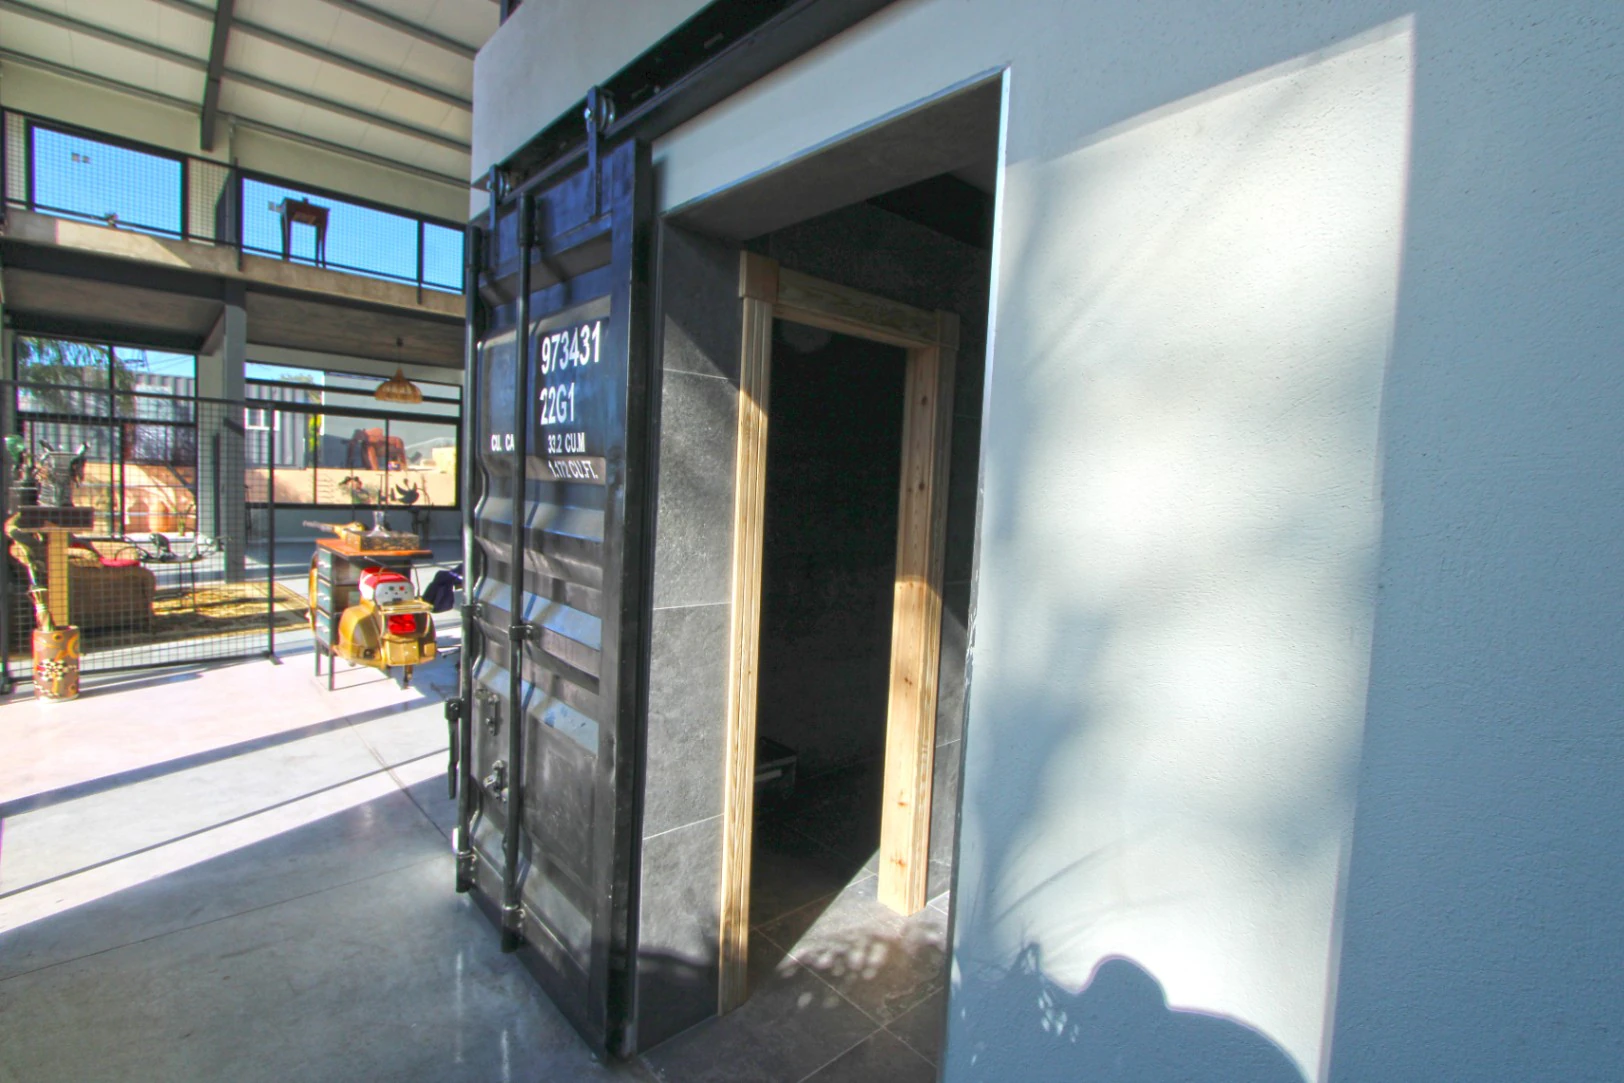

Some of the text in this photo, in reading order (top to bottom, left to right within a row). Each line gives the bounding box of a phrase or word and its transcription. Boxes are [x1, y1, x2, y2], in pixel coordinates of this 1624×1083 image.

[541, 320, 601, 375] 973431
[539, 382, 575, 426] 22G1
[505, 433, 515, 451] CA
